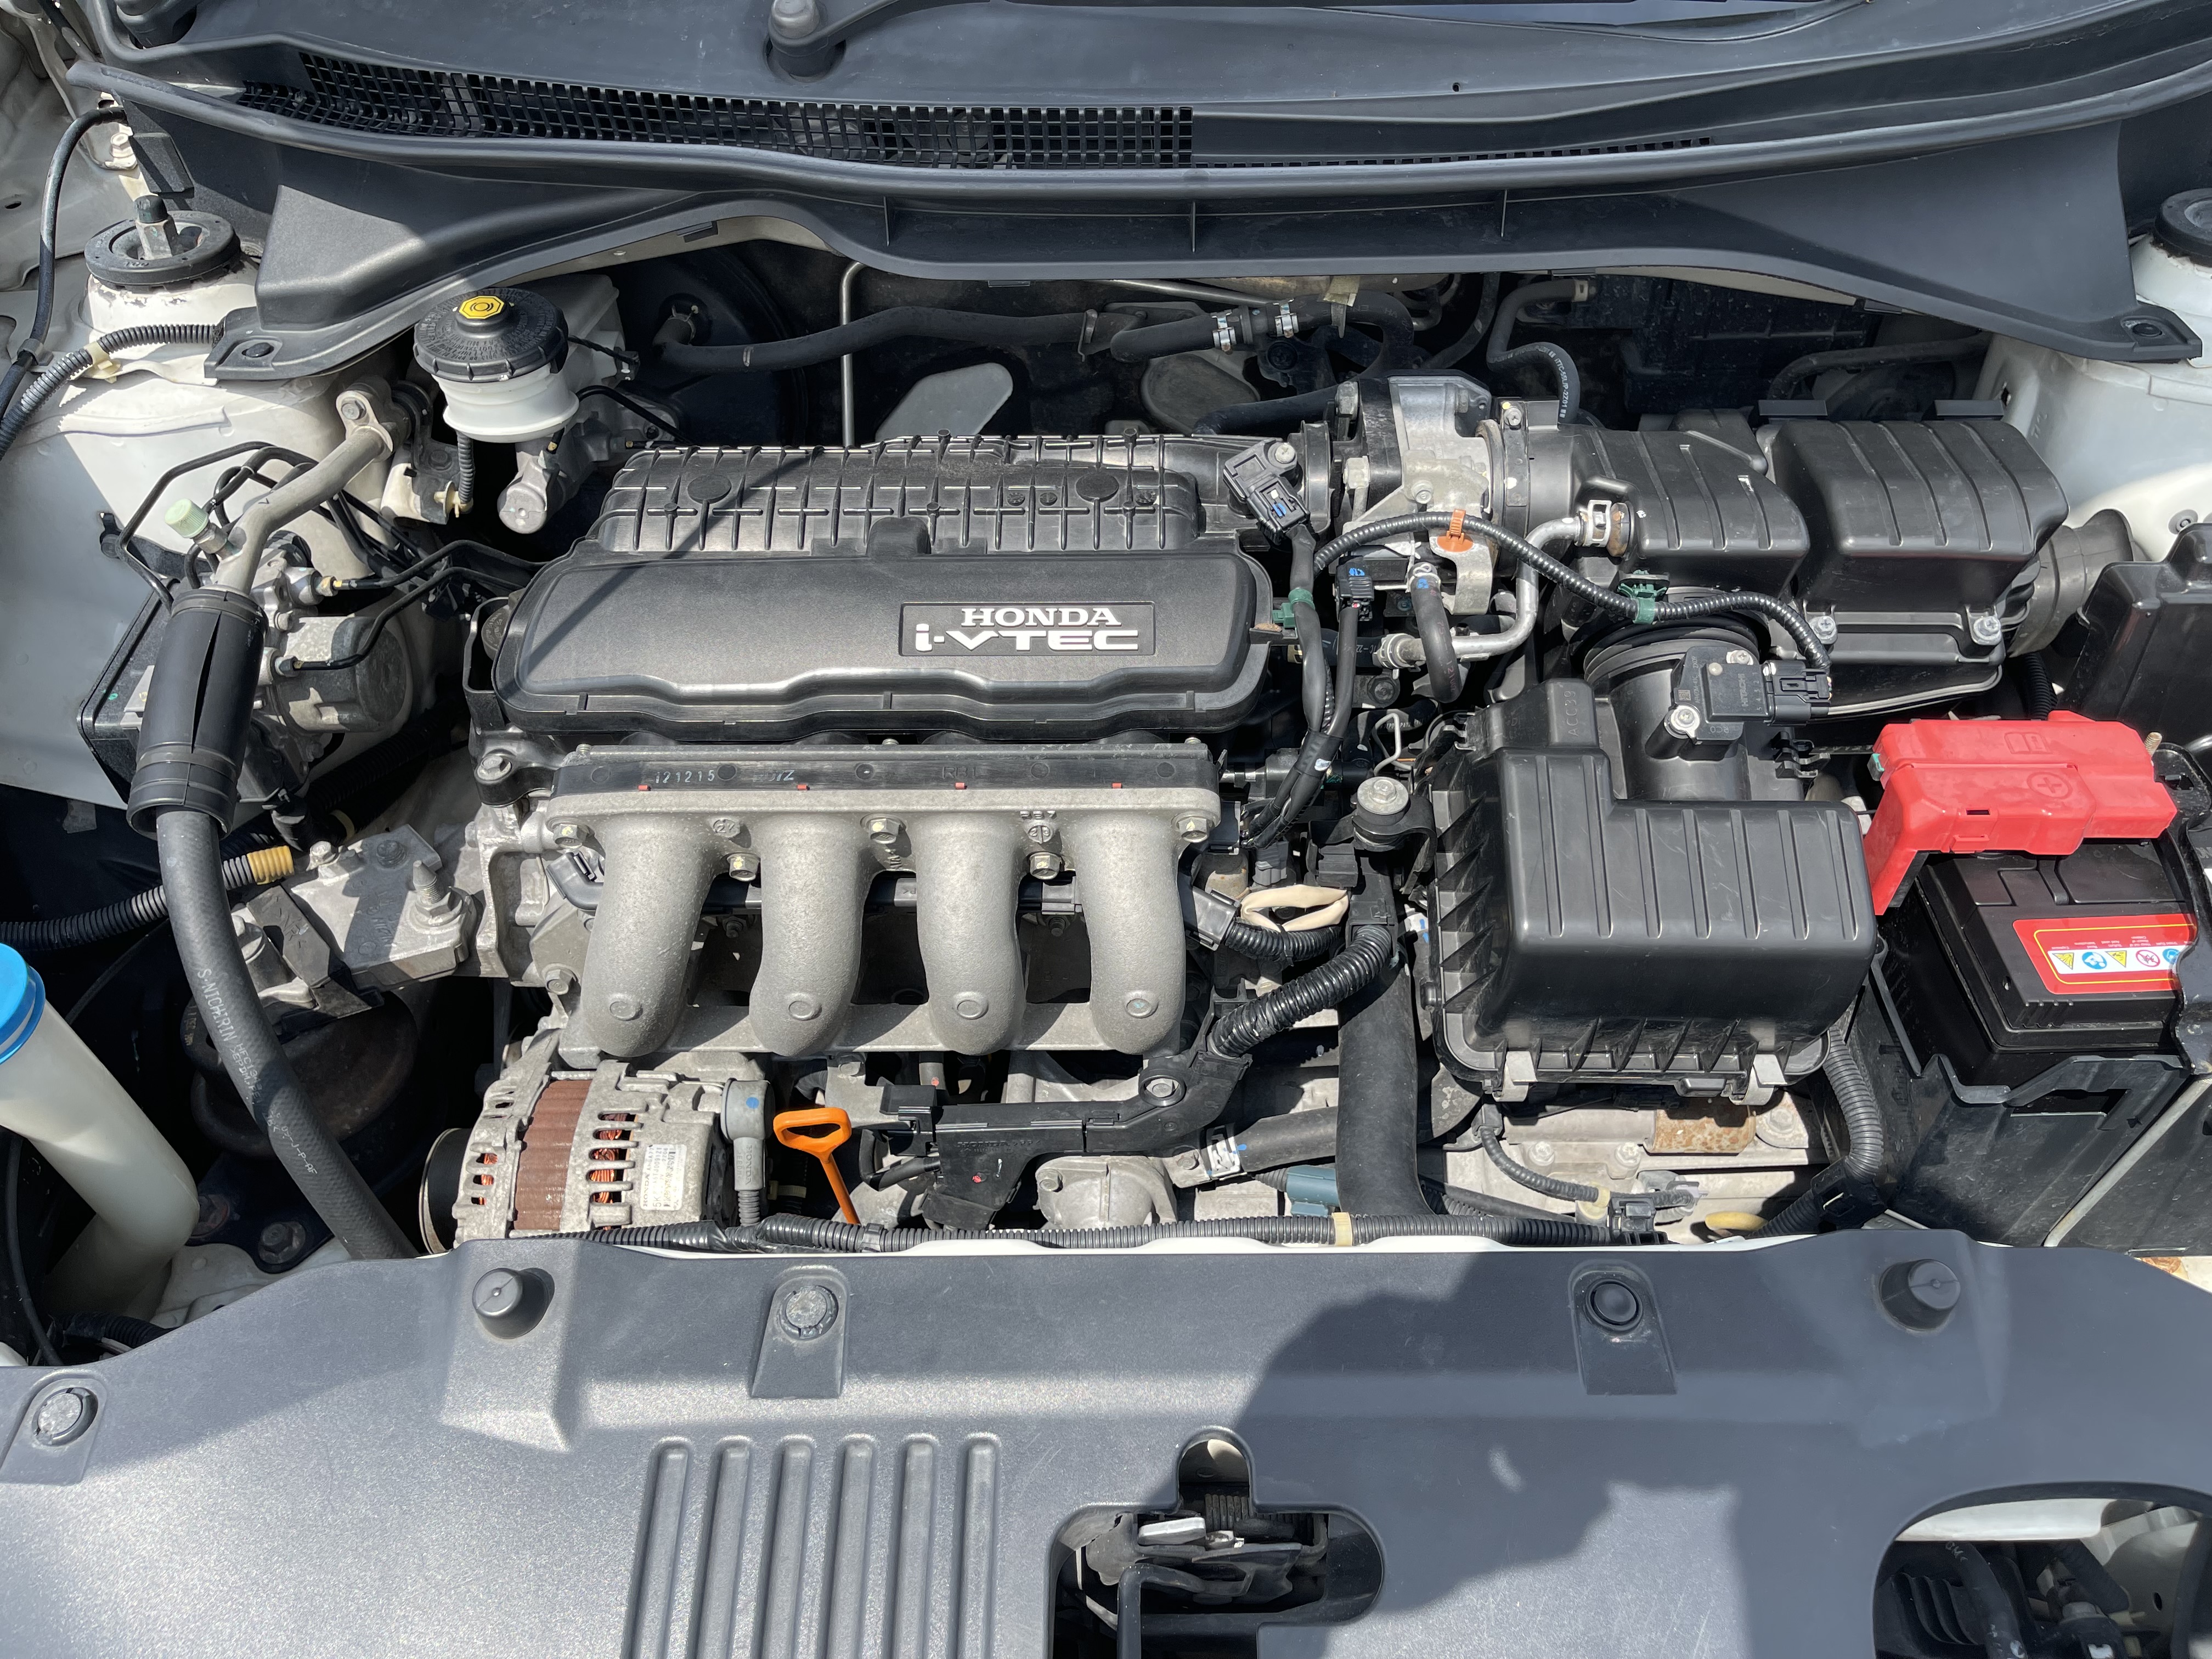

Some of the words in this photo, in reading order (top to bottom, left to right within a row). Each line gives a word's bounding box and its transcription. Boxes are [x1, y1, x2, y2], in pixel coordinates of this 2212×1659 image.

[961, 607, 1122, 627] HONDA
[915, 624, 1139, 651] i-VTEC
[1738, 673, 1749, 707] HITACHI
[1564, 690, 1579, 736] ACC39
[654, 769, 716, 784] 121215
